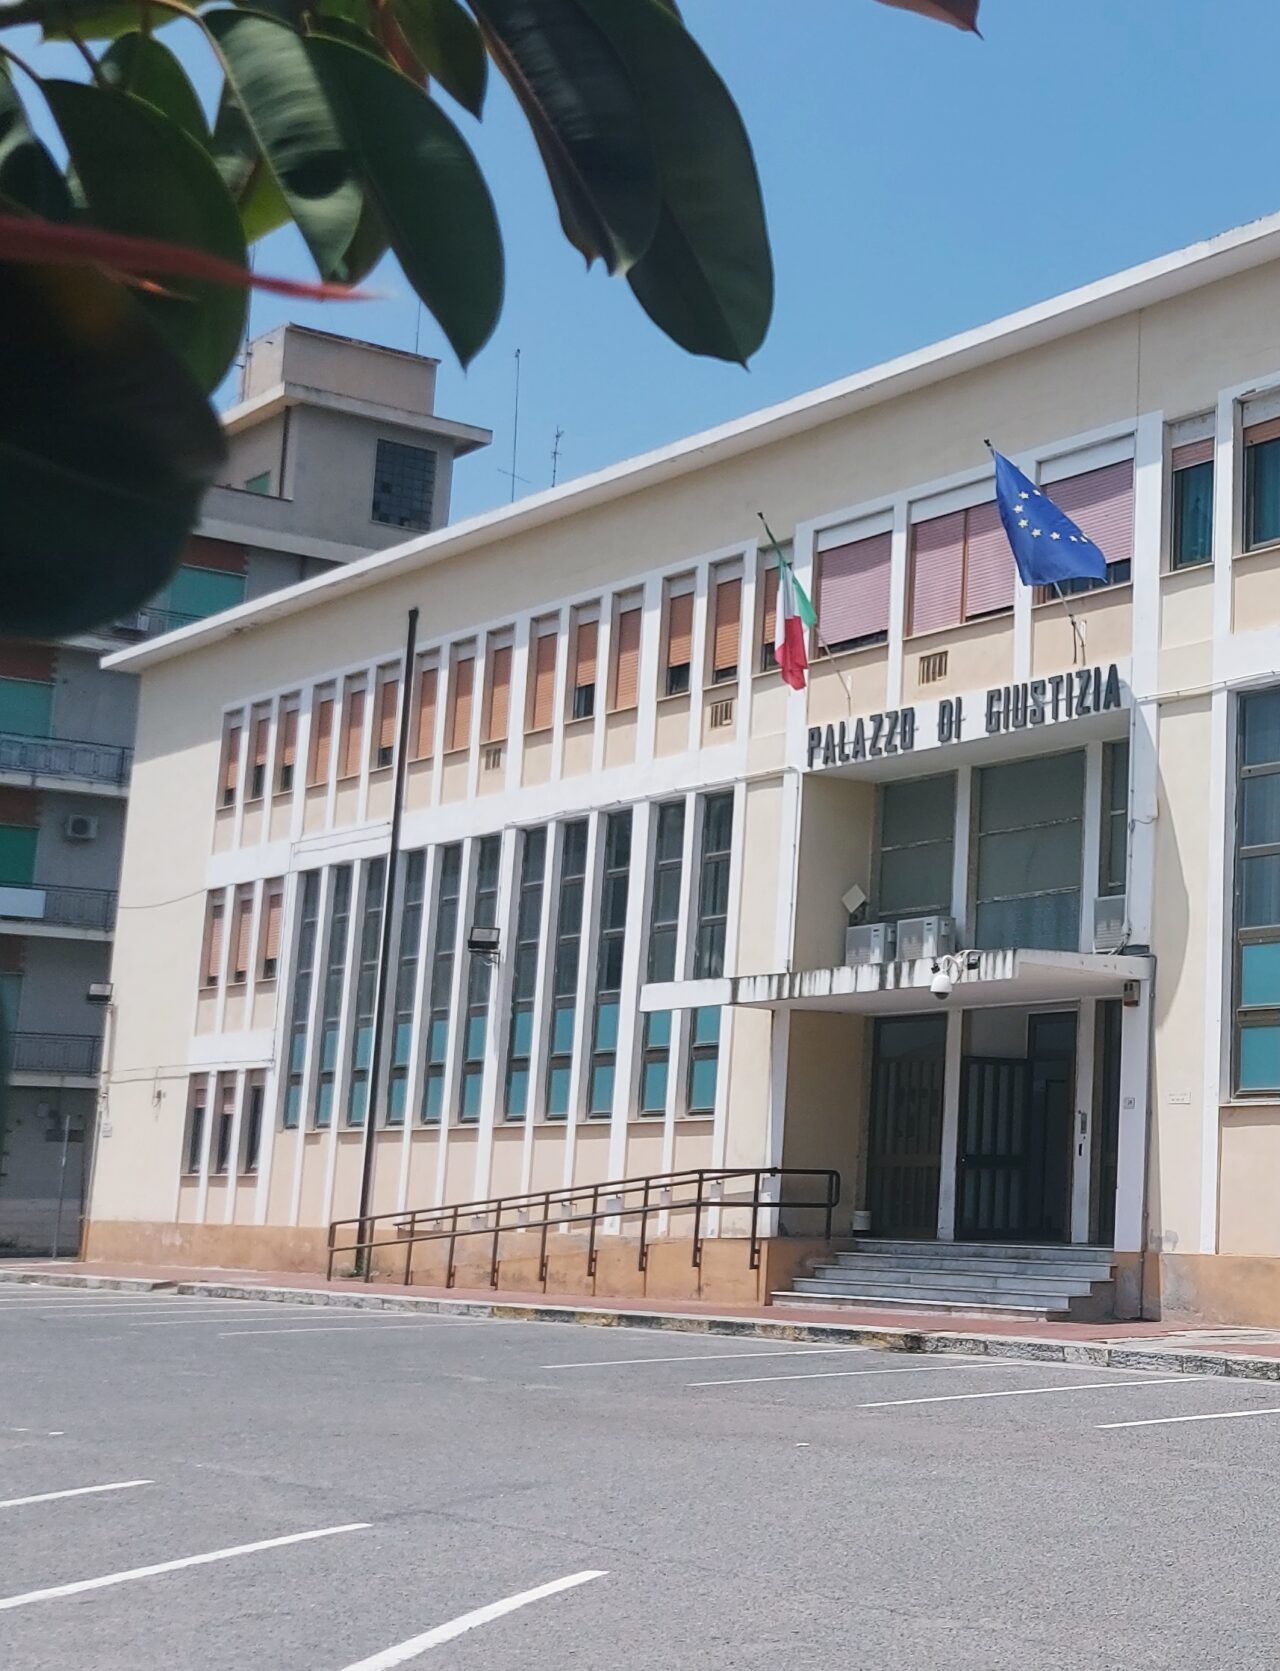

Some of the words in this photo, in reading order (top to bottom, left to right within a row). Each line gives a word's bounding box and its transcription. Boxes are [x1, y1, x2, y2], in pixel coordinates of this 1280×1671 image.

[807, 706, 915, 768] PALAZZO
[937, 696, 962, 743] DI
[985, 663, 1121, 734] GIUSTIZIA
